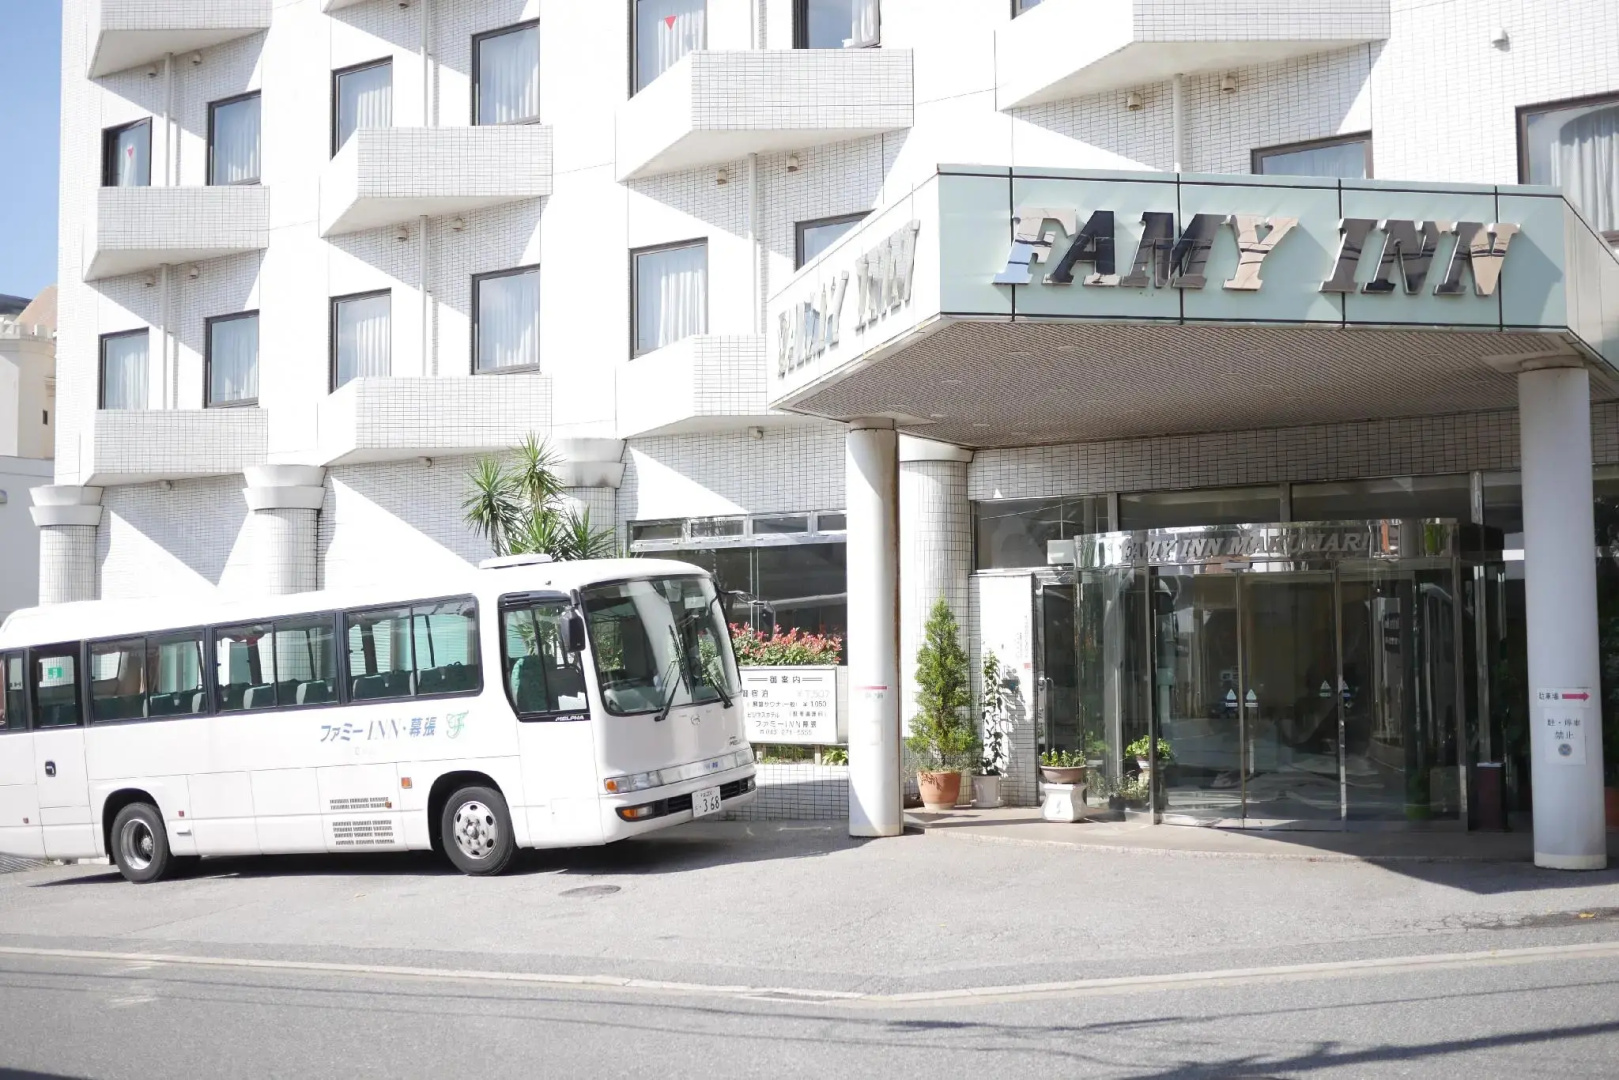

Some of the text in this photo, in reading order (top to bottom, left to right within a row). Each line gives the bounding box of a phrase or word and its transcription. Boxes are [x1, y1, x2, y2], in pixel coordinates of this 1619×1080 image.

[992, 206, 1521, 297] FAMY INN
[1180, 538, 1225, 558] INN
